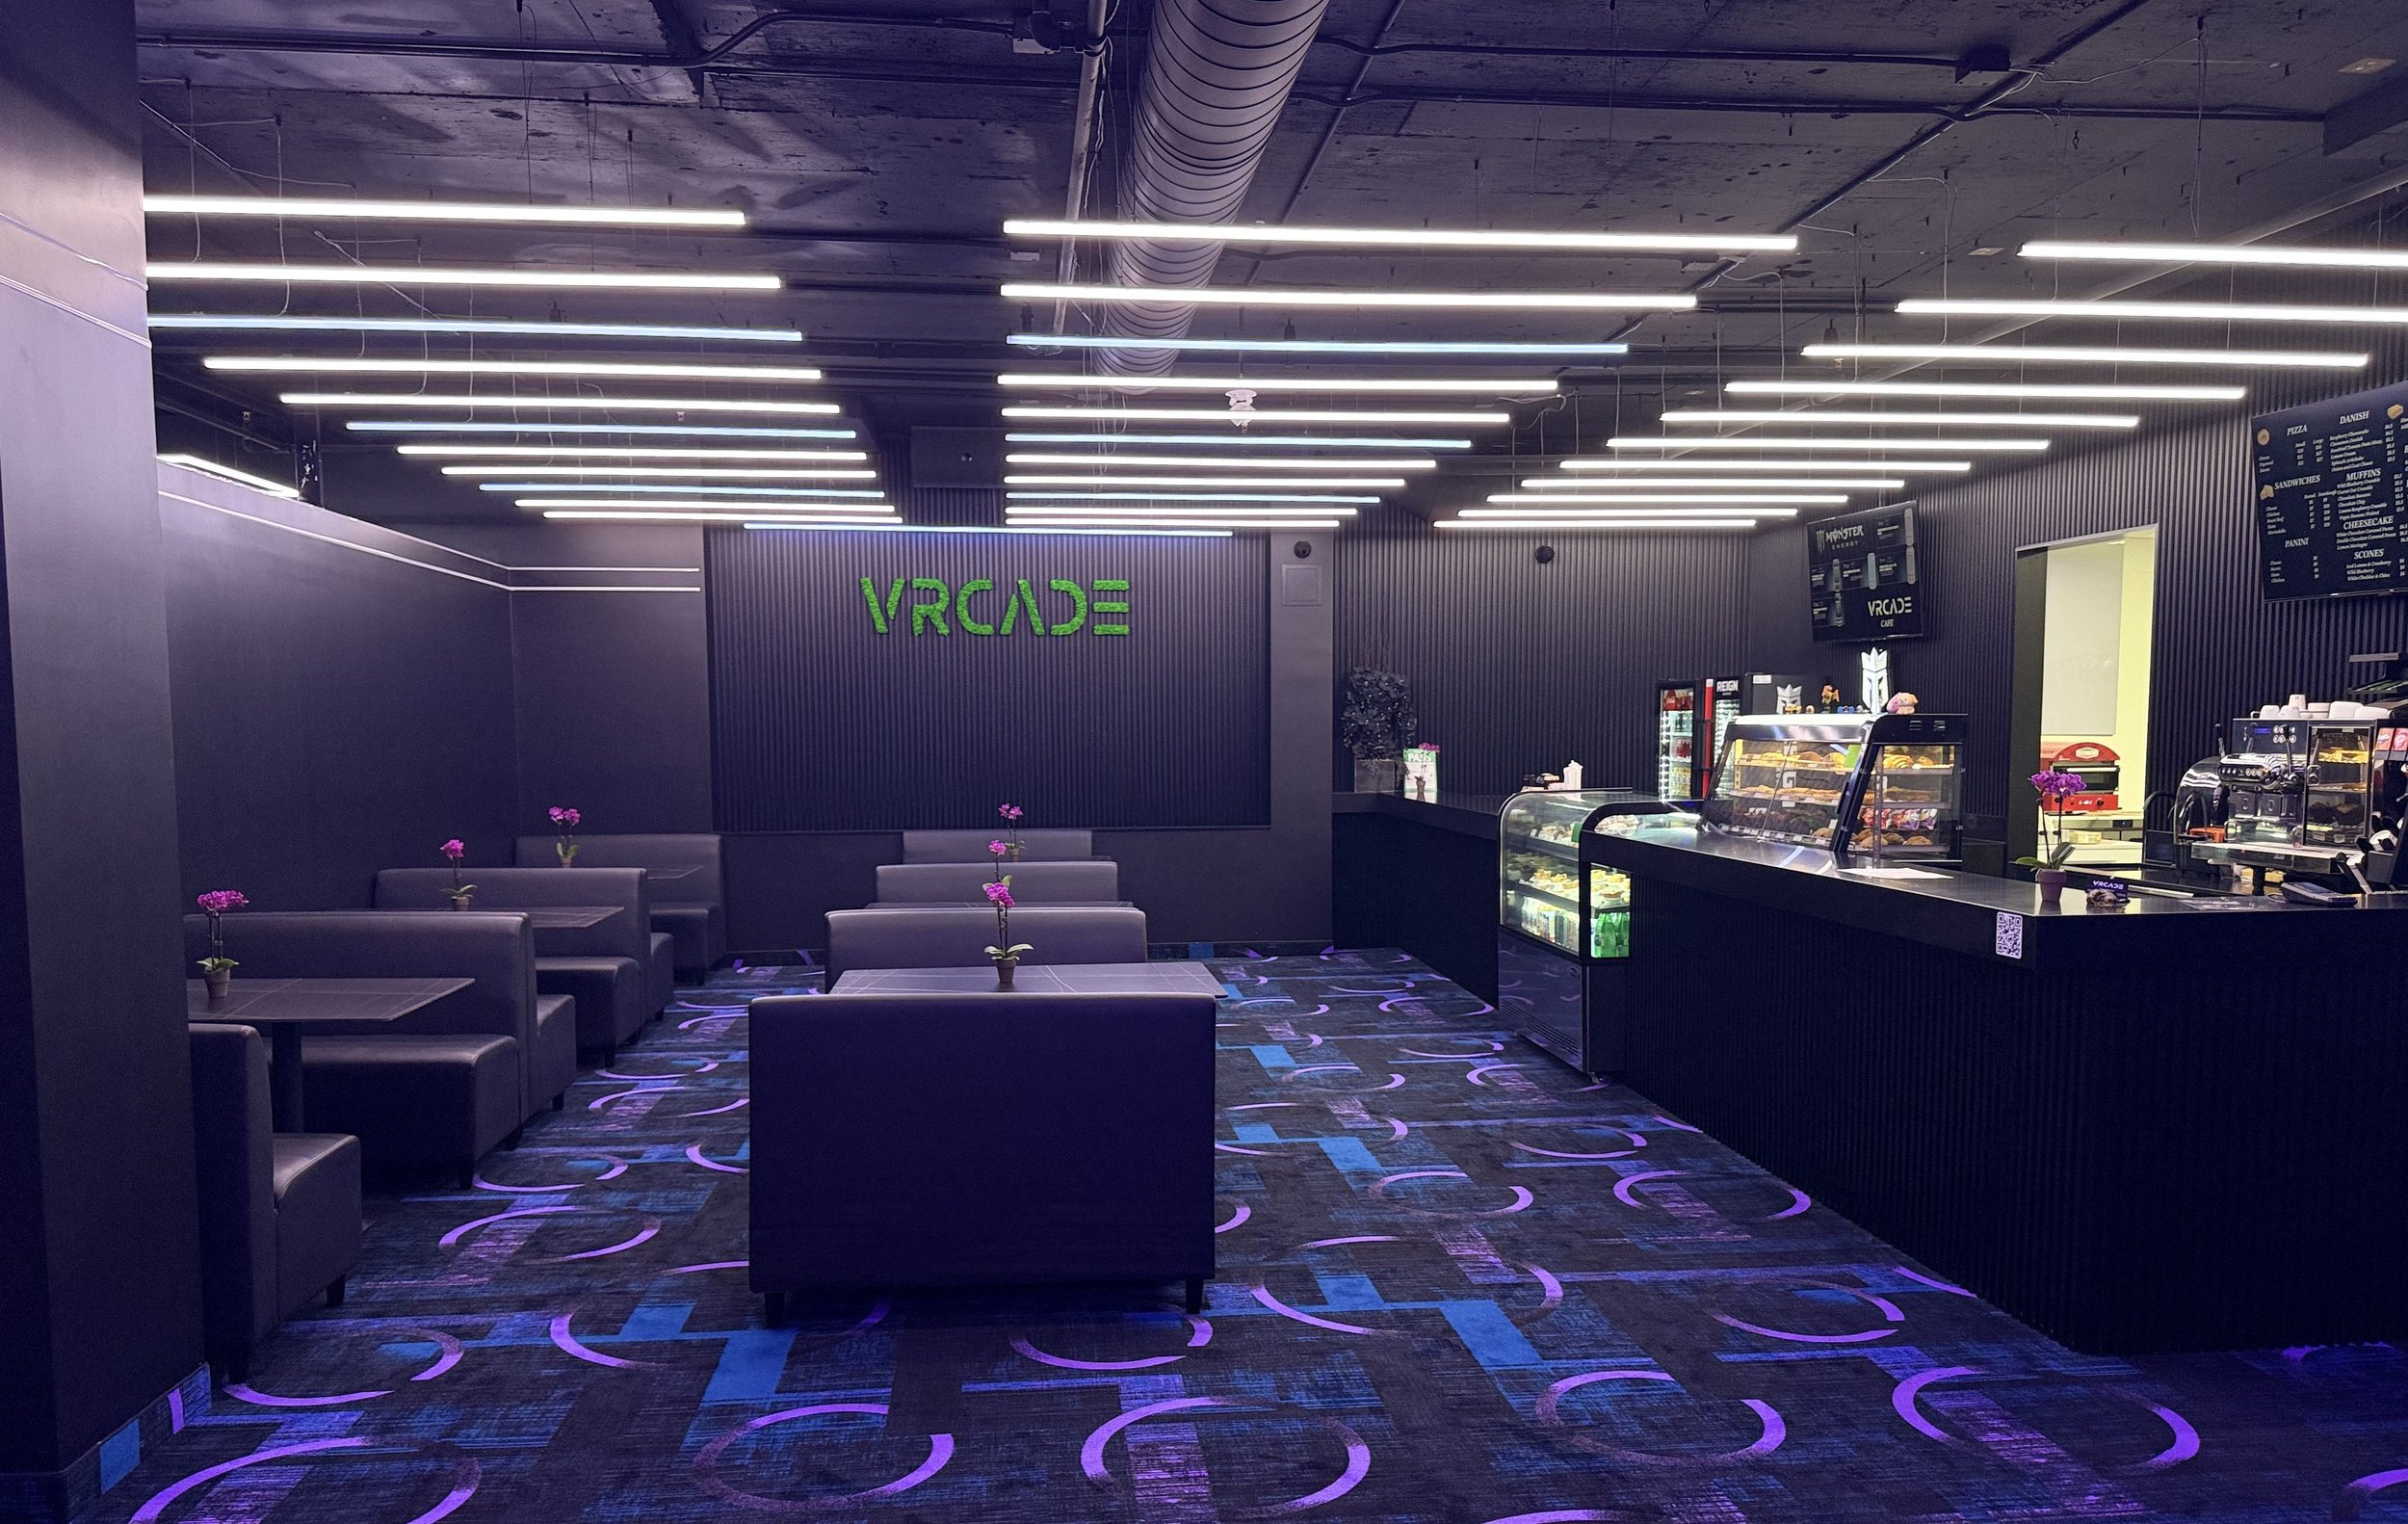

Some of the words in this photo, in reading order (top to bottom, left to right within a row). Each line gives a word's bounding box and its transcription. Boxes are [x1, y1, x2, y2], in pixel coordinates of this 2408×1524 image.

[2340, 411, 2370, 424] DANISH
[2287, 425, 2307, 436] PIZZA
[2346, 469, 2381, 481] MUFFINS
[2275, 475, 2321, 490] SANDWICHES
[2344, 516, 2394, 530] CHEESECAKE
[1825, 525, 1864, 543] MONSTER
[1832, 540, 1859, 550] ENERGY
[2285, 538, 2309, 548] PANINI
[2354, 549, 2384, 559] SCONES
[859, 576, 1130, 637] VRCADE
[1867, 596, 1912, 617] VRCADE
[1880, 618, 1895, 628] CAFE
[1716, 680, 1739, 692] REIGN
[2093, 880, 2124, 890] VRCADE
